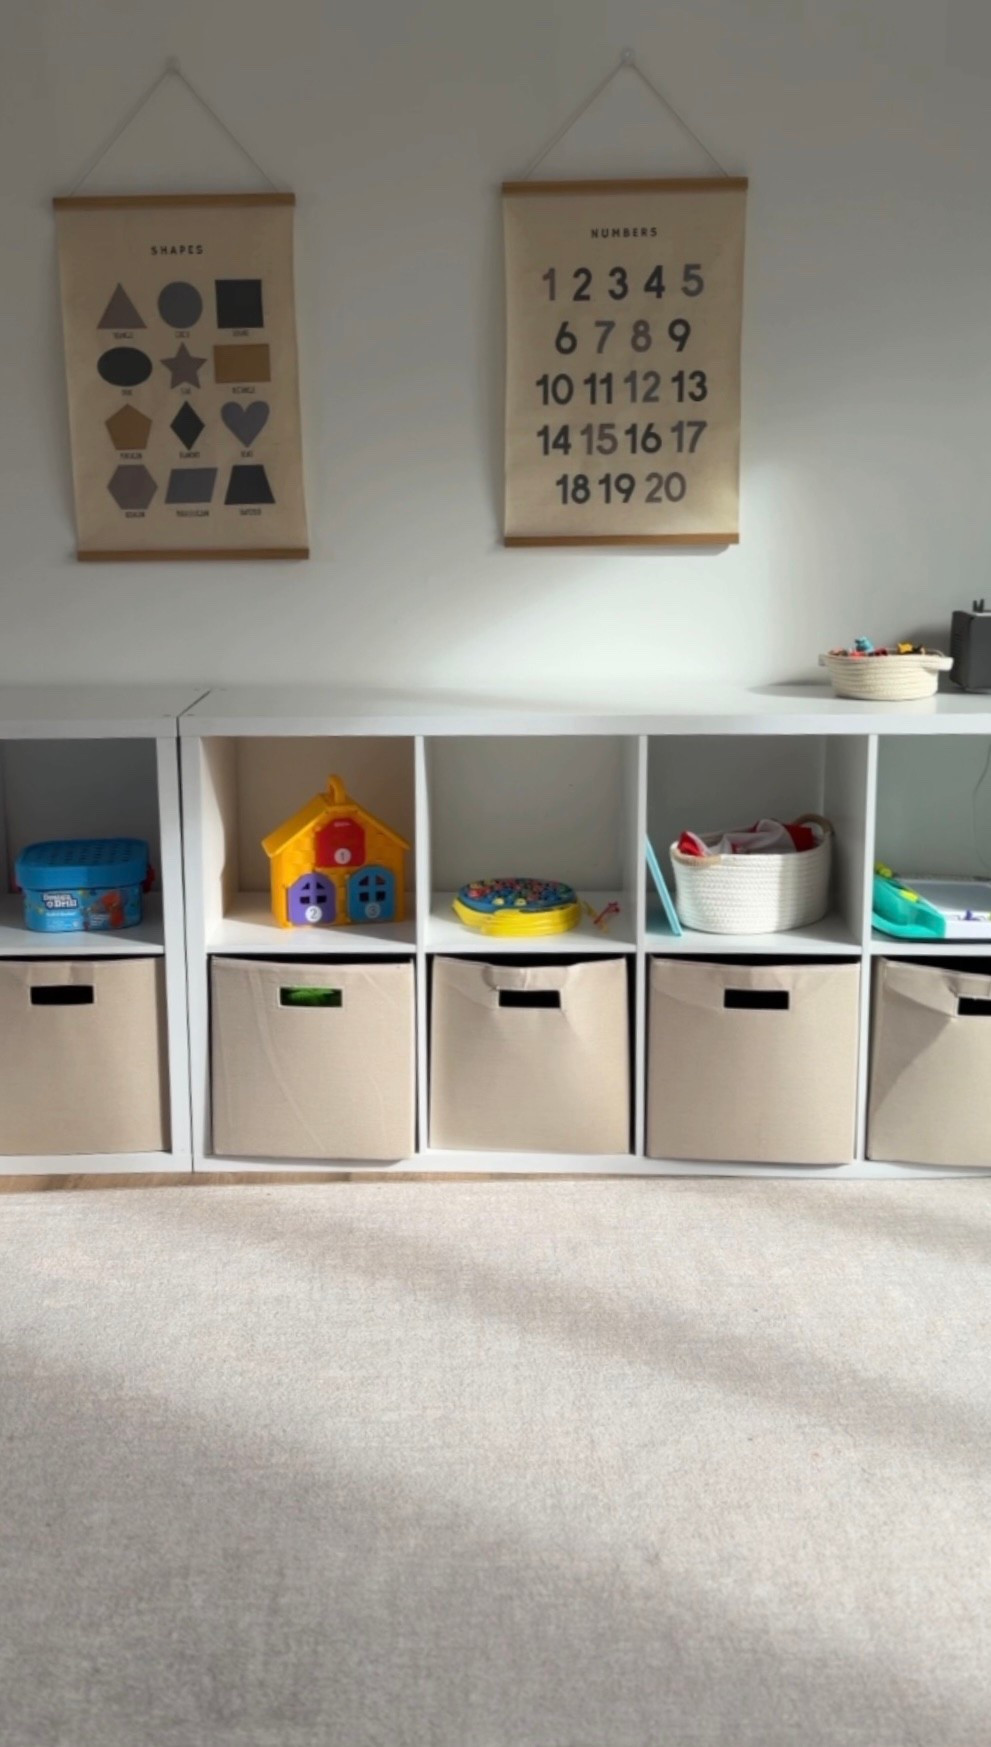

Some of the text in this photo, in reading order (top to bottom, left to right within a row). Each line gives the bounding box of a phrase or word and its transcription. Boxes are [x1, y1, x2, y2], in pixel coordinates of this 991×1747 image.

[150, 244, 204, 257] SHAPES
[590, 226, 658, 240] NUMBERS
[542, 263, 705, 302] 1 2 3 4 5
[555, 318, 692, 356] 6 7 8 9
[535, 370, 709, 406] 10 11 12 13
[536, 420, 709, 456] 14 15 16 17
[555, 471, 688, 506] 18 19 20
